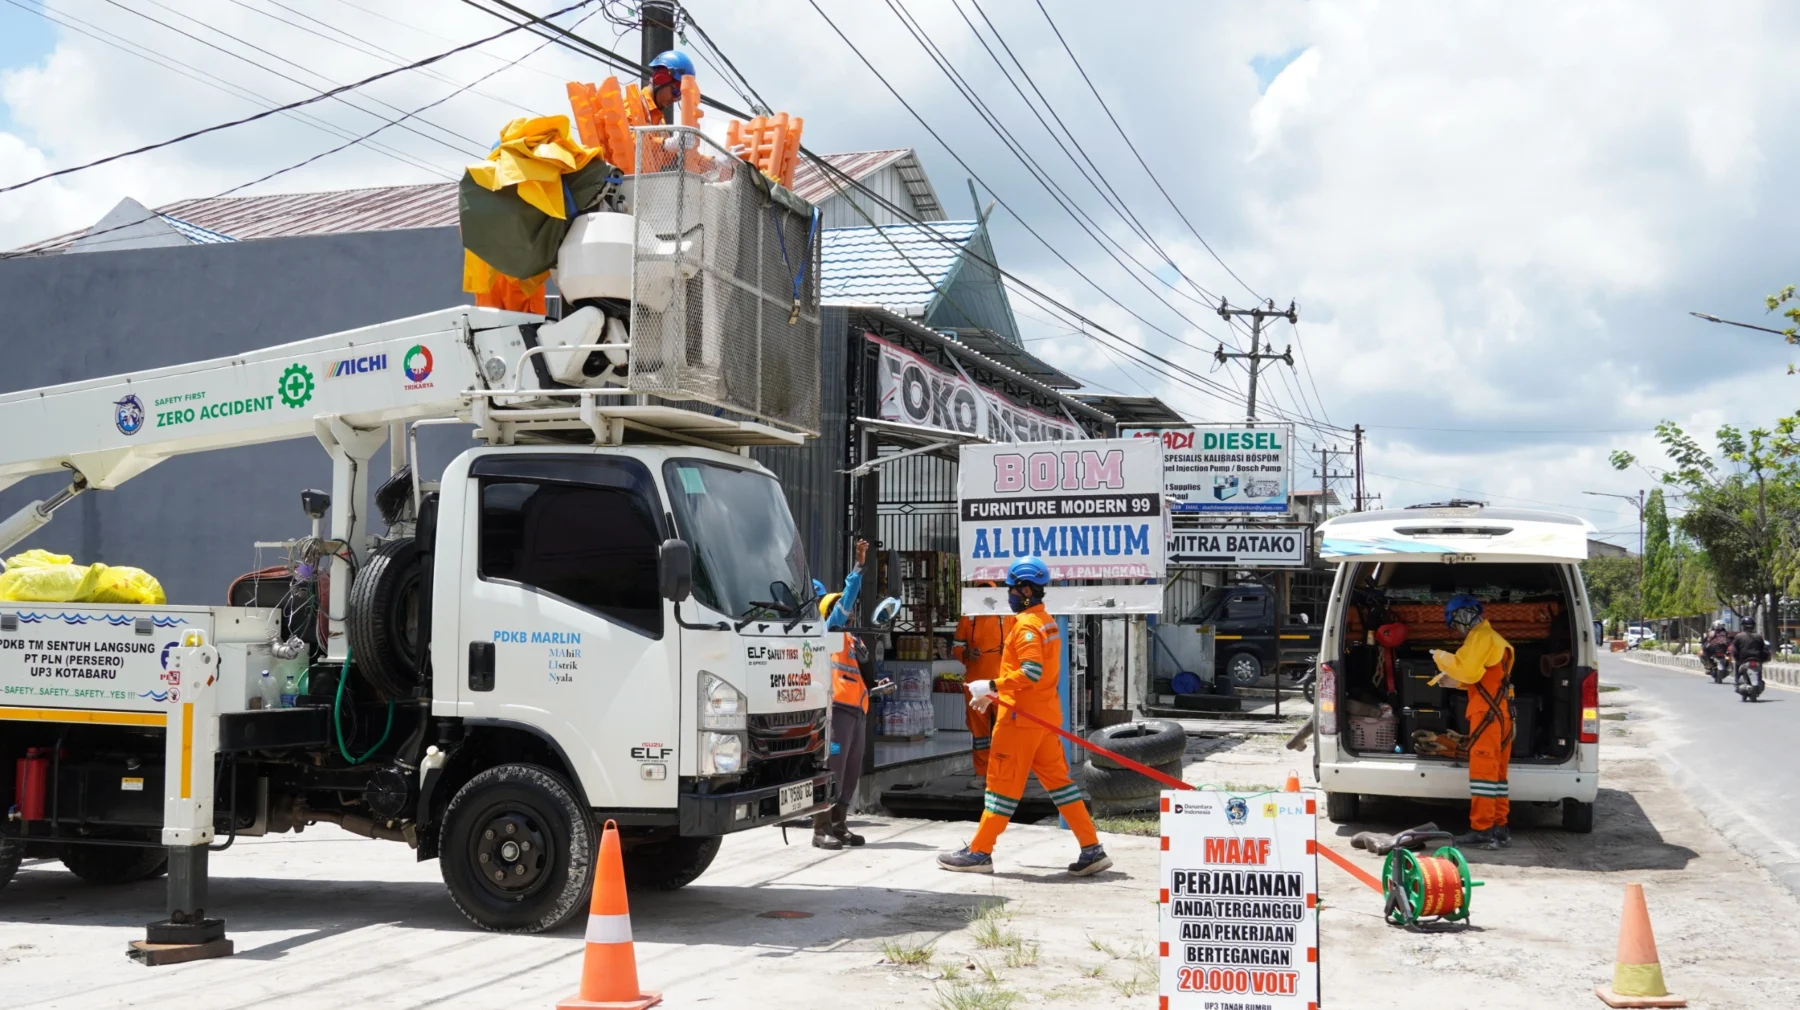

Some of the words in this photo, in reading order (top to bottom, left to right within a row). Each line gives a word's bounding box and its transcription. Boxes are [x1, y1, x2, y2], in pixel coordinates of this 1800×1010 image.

[336, 354, 387, 376] AICHI
[404, 382, 434, 391] TRIKARYA
[155, 395, 183, 407] SAFETY
[185, 391, 207, 402] FIRST
[157, 408, 195, 428] ZERO
[200, 395, 274, 421] ACCIDENT
[1133, 431, 1195, 450] ADI
[1204, 432, 1282, 450] DIESEL
[1164, 454, 1203, 463] SPESIALIS
[1204, 454, 1245, 463] KALIBRASI
[1246, 453, 1280, 463] BOSPOM
[994, 449, 1124, 493] BOIM
[1164, 464, 1175, 473] uel
[1176, 464, 1209, 474] Injection
[1210, 464, 1231, 474] Pump
[1237, 464, 1259, 473] Bosch
[1260, 464, 1282, 474] Pump
[1170, 483, 1201, 492] Supplies
[970, 499, 1056, 517] FURNITURE
[1061, 498, 1128, 515] MODERN
[1131, 498, 1151, 513] 99
[972, 524, 1150, 559] ALUMINIUM
[1167, 535, 1220, 552] MITRA
[1227, 535, 1295, 553] BATAKO
[1066, 566, 1075, 578] 4
[494, 630, 527, 644] PDKB
[531, 631, 581, 644] MARLIN
[29, 640, 44, 651] TM
[47, 641, 91, 653] SENTUH
[94, 643, 155, 654] LANGSUNG
[549, 648, 581, 658] MAhiR
[747, 646, 766, 659] ELF
[24, 653, 38, 664] PT
[41, 654, 62, 665] PLN
[65, 654, 125, 668] (PERSERO)
[548, 660, 578, 670] LIstrik
[31, 667, 52, 678] UP3
[55, 667, 117, 680] KOTABARU
[548, 673, 573, 685] Nyala
[127, 691, 136, 700] !!!
[630, 747, 674, 759] ELF
[1278, 806, 1303, 816] PLN
[1204, 837, 1271, 865] MAAF
[1173, 871, 1302, 897] PERJALANAN
[1174, 901, 1213, 917] ANDA
[1215, 901, 1303, 920] TERGANGGU
[1182, 924, 1212, 940] ADA
[1214, 924, 1295, 942] PEKERJAAN
[1186, 947, 1291, 966] BERTEGANGAN
[1178, 968, 1249, 991] 20.000
[1252, 971, 1298, 994] VOLT
[1204, 1002, 1219, 1010] UP3
[1221, 1002, 1244, 1010] TANAH
